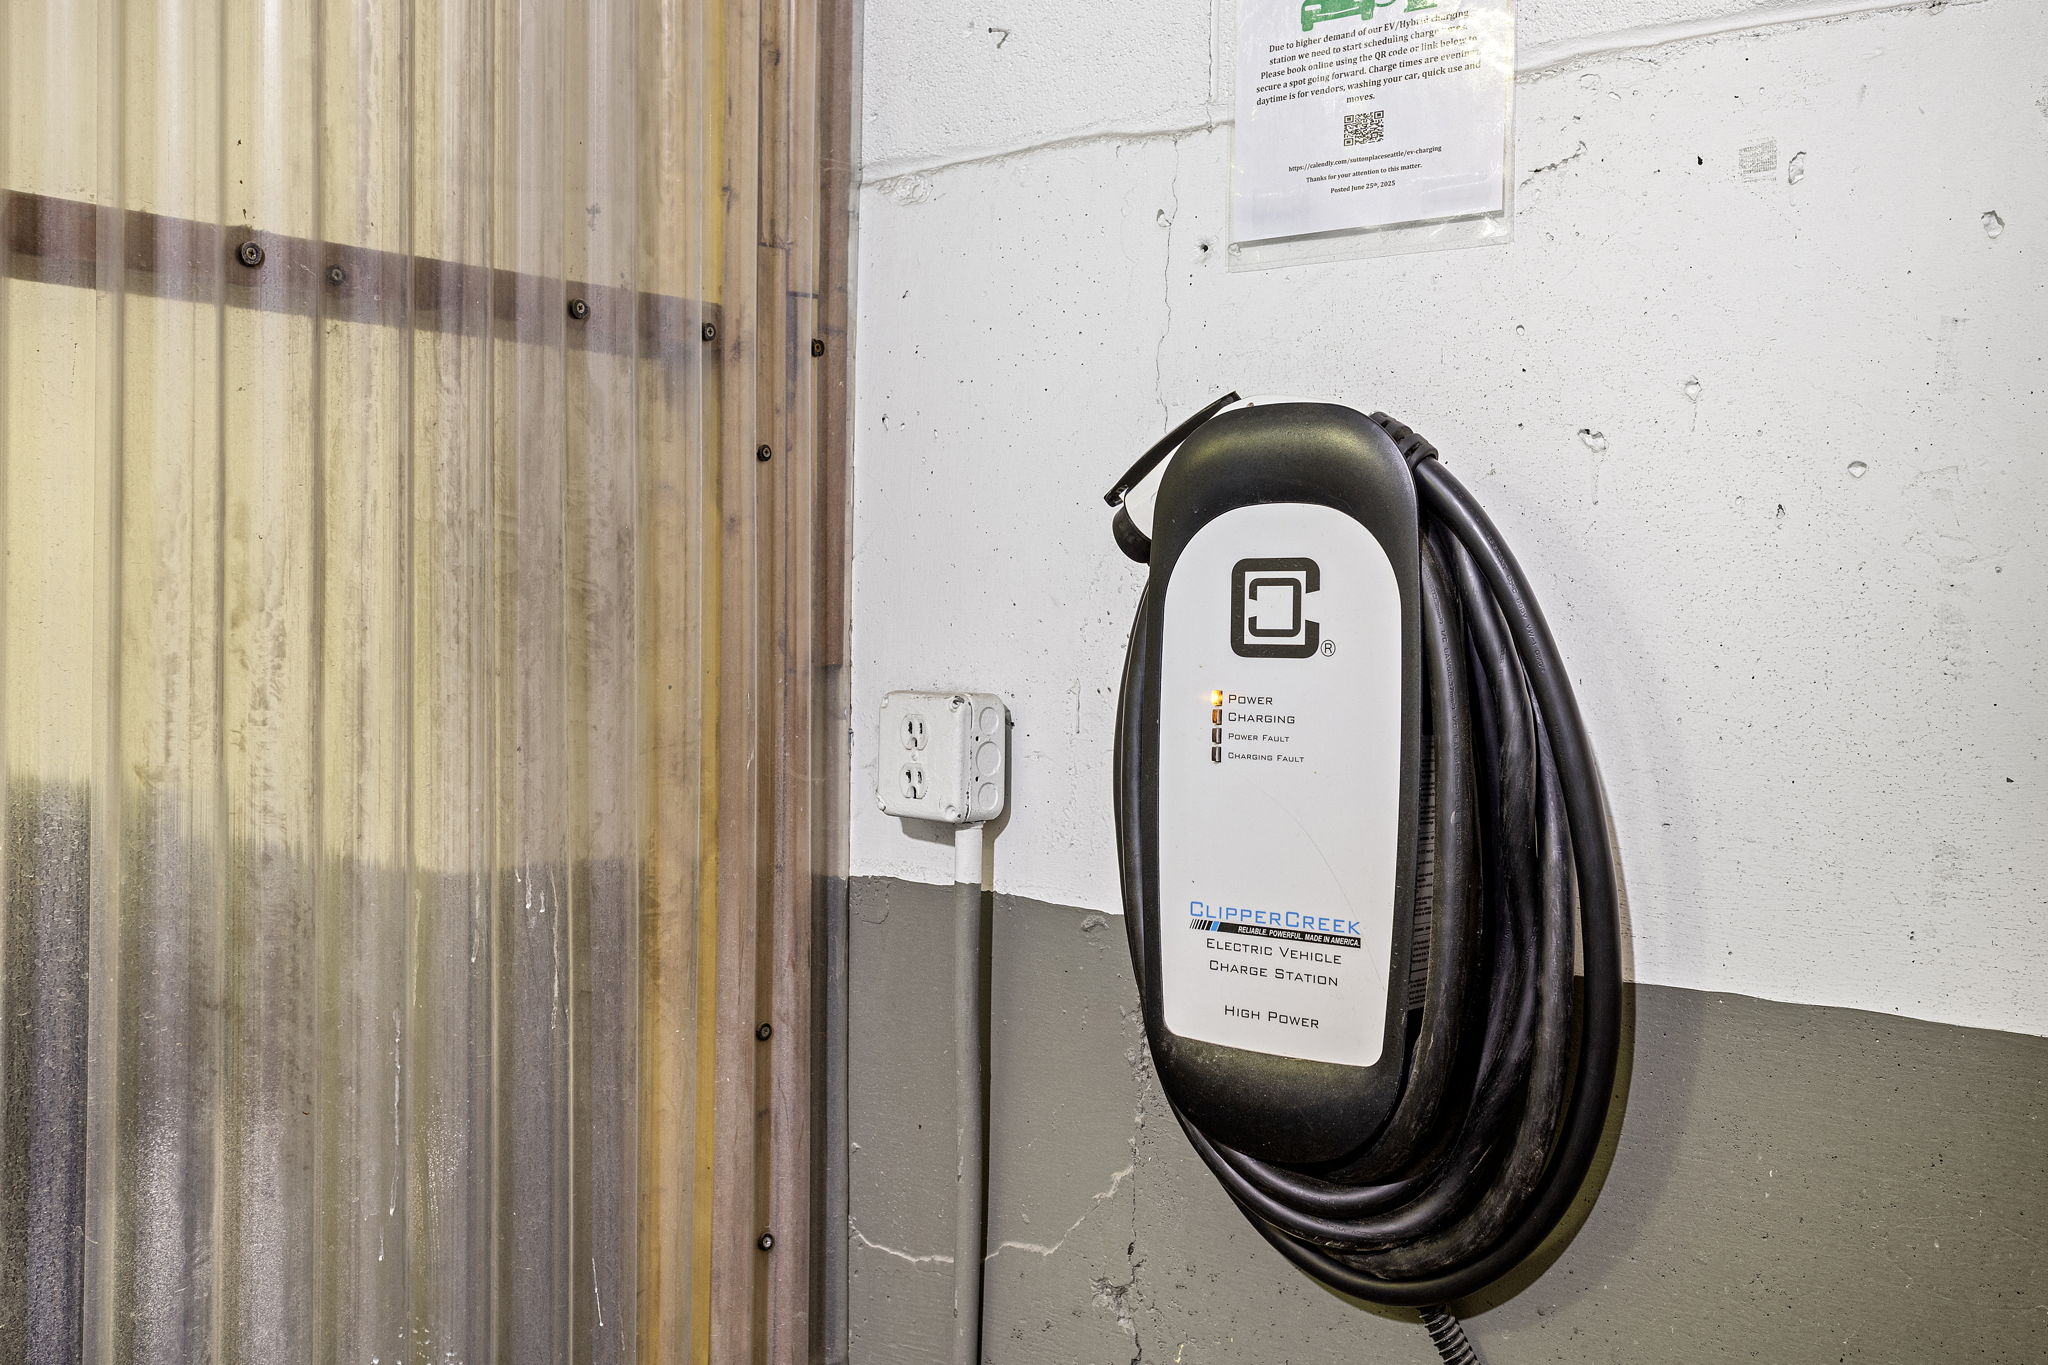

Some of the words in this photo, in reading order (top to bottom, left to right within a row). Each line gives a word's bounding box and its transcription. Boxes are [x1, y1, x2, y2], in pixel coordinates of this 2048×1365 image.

[1269, 44, 1284, 52] Due
[1286, 42, 1294, 50] to
[1295, 37, 1322, 48] higher
[1323, 30, 1356, 42] demand
[1358, 27, 1366, 36] of
[1368, 25, 1382, 34] our
[1384, 16, 1429, 32] EV/Hybrd
[1430, 10, 1469, 23] charging
[1260, 68, 1286, 80] Please
[1286, 64, 1306, 74] book
[1308, 60, 1334, 70] online
[1336, 56, 1358, 66] using
[1360, 54, 1372, 62] the
[1374, 50, 1386, 60] QR
[1388, 46, 1408, 56] code
[1421, 40, 1438, 51] link
[1440, 37, 1466, 48] below
[1269, 55, 1296, 66] station
[1298, 52, 1310, 60] we
[1311, 47, 1331, 57] need
[1342, 42, 1362, 52] start
[1364, 34, 1408, 48] scheduling
[1256, 82, 1282, 92] secure
[1289, 78, 1306, 88] spot
[1307, 74, 1330, 86] going
[1332, 66, 1366, 80] forward.
[1368, 62, 1397, 74] Charge
[1399, 58, 1422, 68] times
[1424, 55, 1438, 64] are
[1256, 94, 1288, 106] daytime
[1289, 92, 1296, 100] is
[1298, 90, 1309, 98] for
[1310, 84, 1346, 96] vendors,
[1347, 79, 1382, 91] washing
[1383, 75, 1403, 86] your
[1404, 72, 1420, 80] car,
[1422, 66, 1446, 79] quick
[1448, 64, 1463, 73] use
[1464, 60, 1480, 70] and
[1346, 93, 1376, 104] moves.
[1306, 175, 1327, 184] Thanks
[1337, 172, 1352, 180] your
[1352, 167, 1380, 177] attention
[1400, 162, 1422, 171] matter.
[1330, 186, 1350, 194] Posted
[1351, 184, 1364, 192] June
[1380, 180, 1396, 188] 2025
[1228, 694, 1273, 706] POWER
[1228, 711, 1296, 725] CHARGING
[1228, 732, 1259, 742] POWER
[1262, 734, 1290, 743] FAULT
[1227, 751, 1273, 762] CHARGING
[1276, 754, 1305, 764] FAULT
[1238, 925, 1268, 936] RELIABLE.
[1268, 928, 1304, 940] POWERFUL.
[1304, 934, 1323, 943] MADE
[1324, 936, 1330, 944] IN
[1330, 936, 1361, 948] AMERICA.
[1206, 938, 1273, 957] ELECTRIC
[1279, 946, 1342, 965] VEHICLE
[1209, 960, 1268, 978] CHARGE
[1275, 968, 1339, 987] STATION
[1224, 1004, 1260, 1021] HIGH
[1268, 1010, 1320, 1030] POWER
